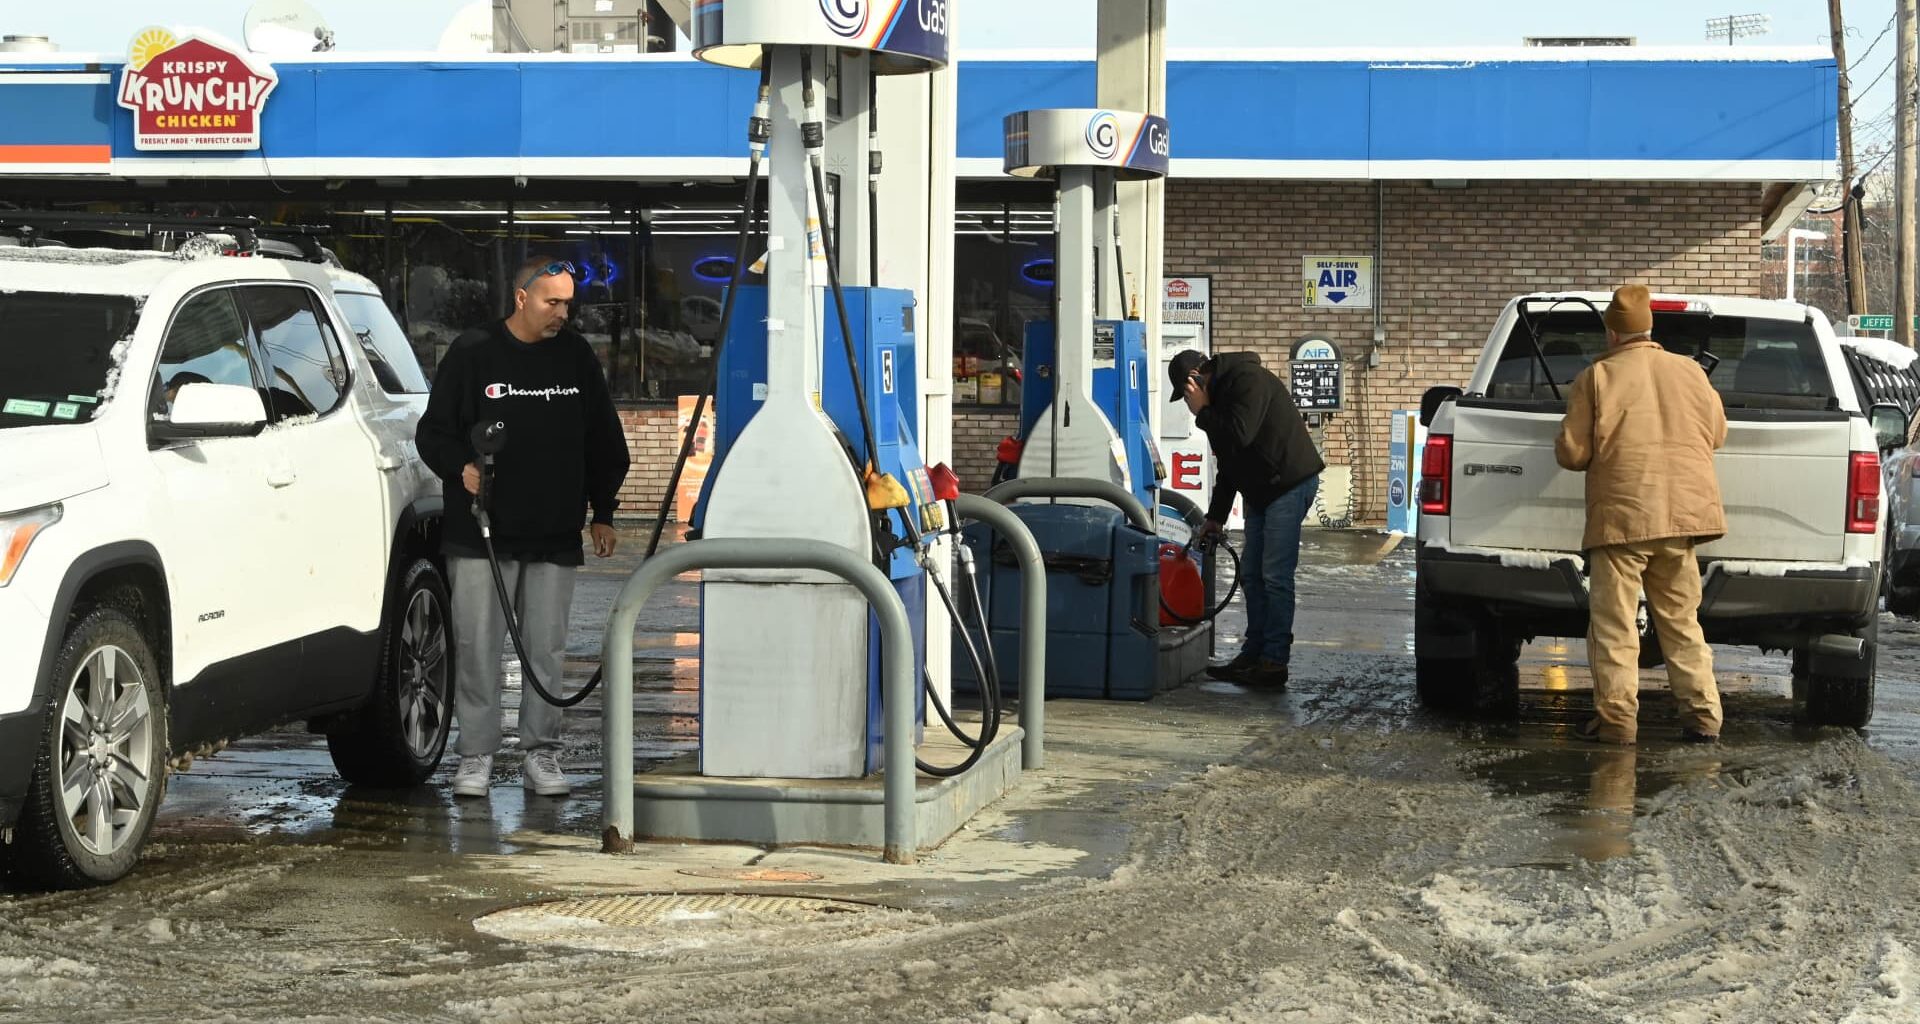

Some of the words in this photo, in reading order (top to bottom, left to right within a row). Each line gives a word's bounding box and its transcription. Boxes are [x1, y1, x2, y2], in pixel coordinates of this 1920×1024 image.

[917, 0, 948, 37] Gas
[162, 60, 228, 74] KRISPY
[125, 73, 268, 112] KRUNCHY
[155, 114, 236, 128] CHICKEN
[140, 137, 168, 145] FRESHLY
[1096, 123, 1113, 148] G
[1316, 261, 1359, 269] SELF-SERVE
[1318, 269, 1358, 288] AIR
[1306, 280, 1314, 304] AIR
[1176, 301, 1206, 310] FRESHLY
[883, 352, 892, 392] 5
[485, 383, 580, 401] Champion
[1391, 460, 1405, 471] ZYN
[198, 609, 225, 623] ACADIA
